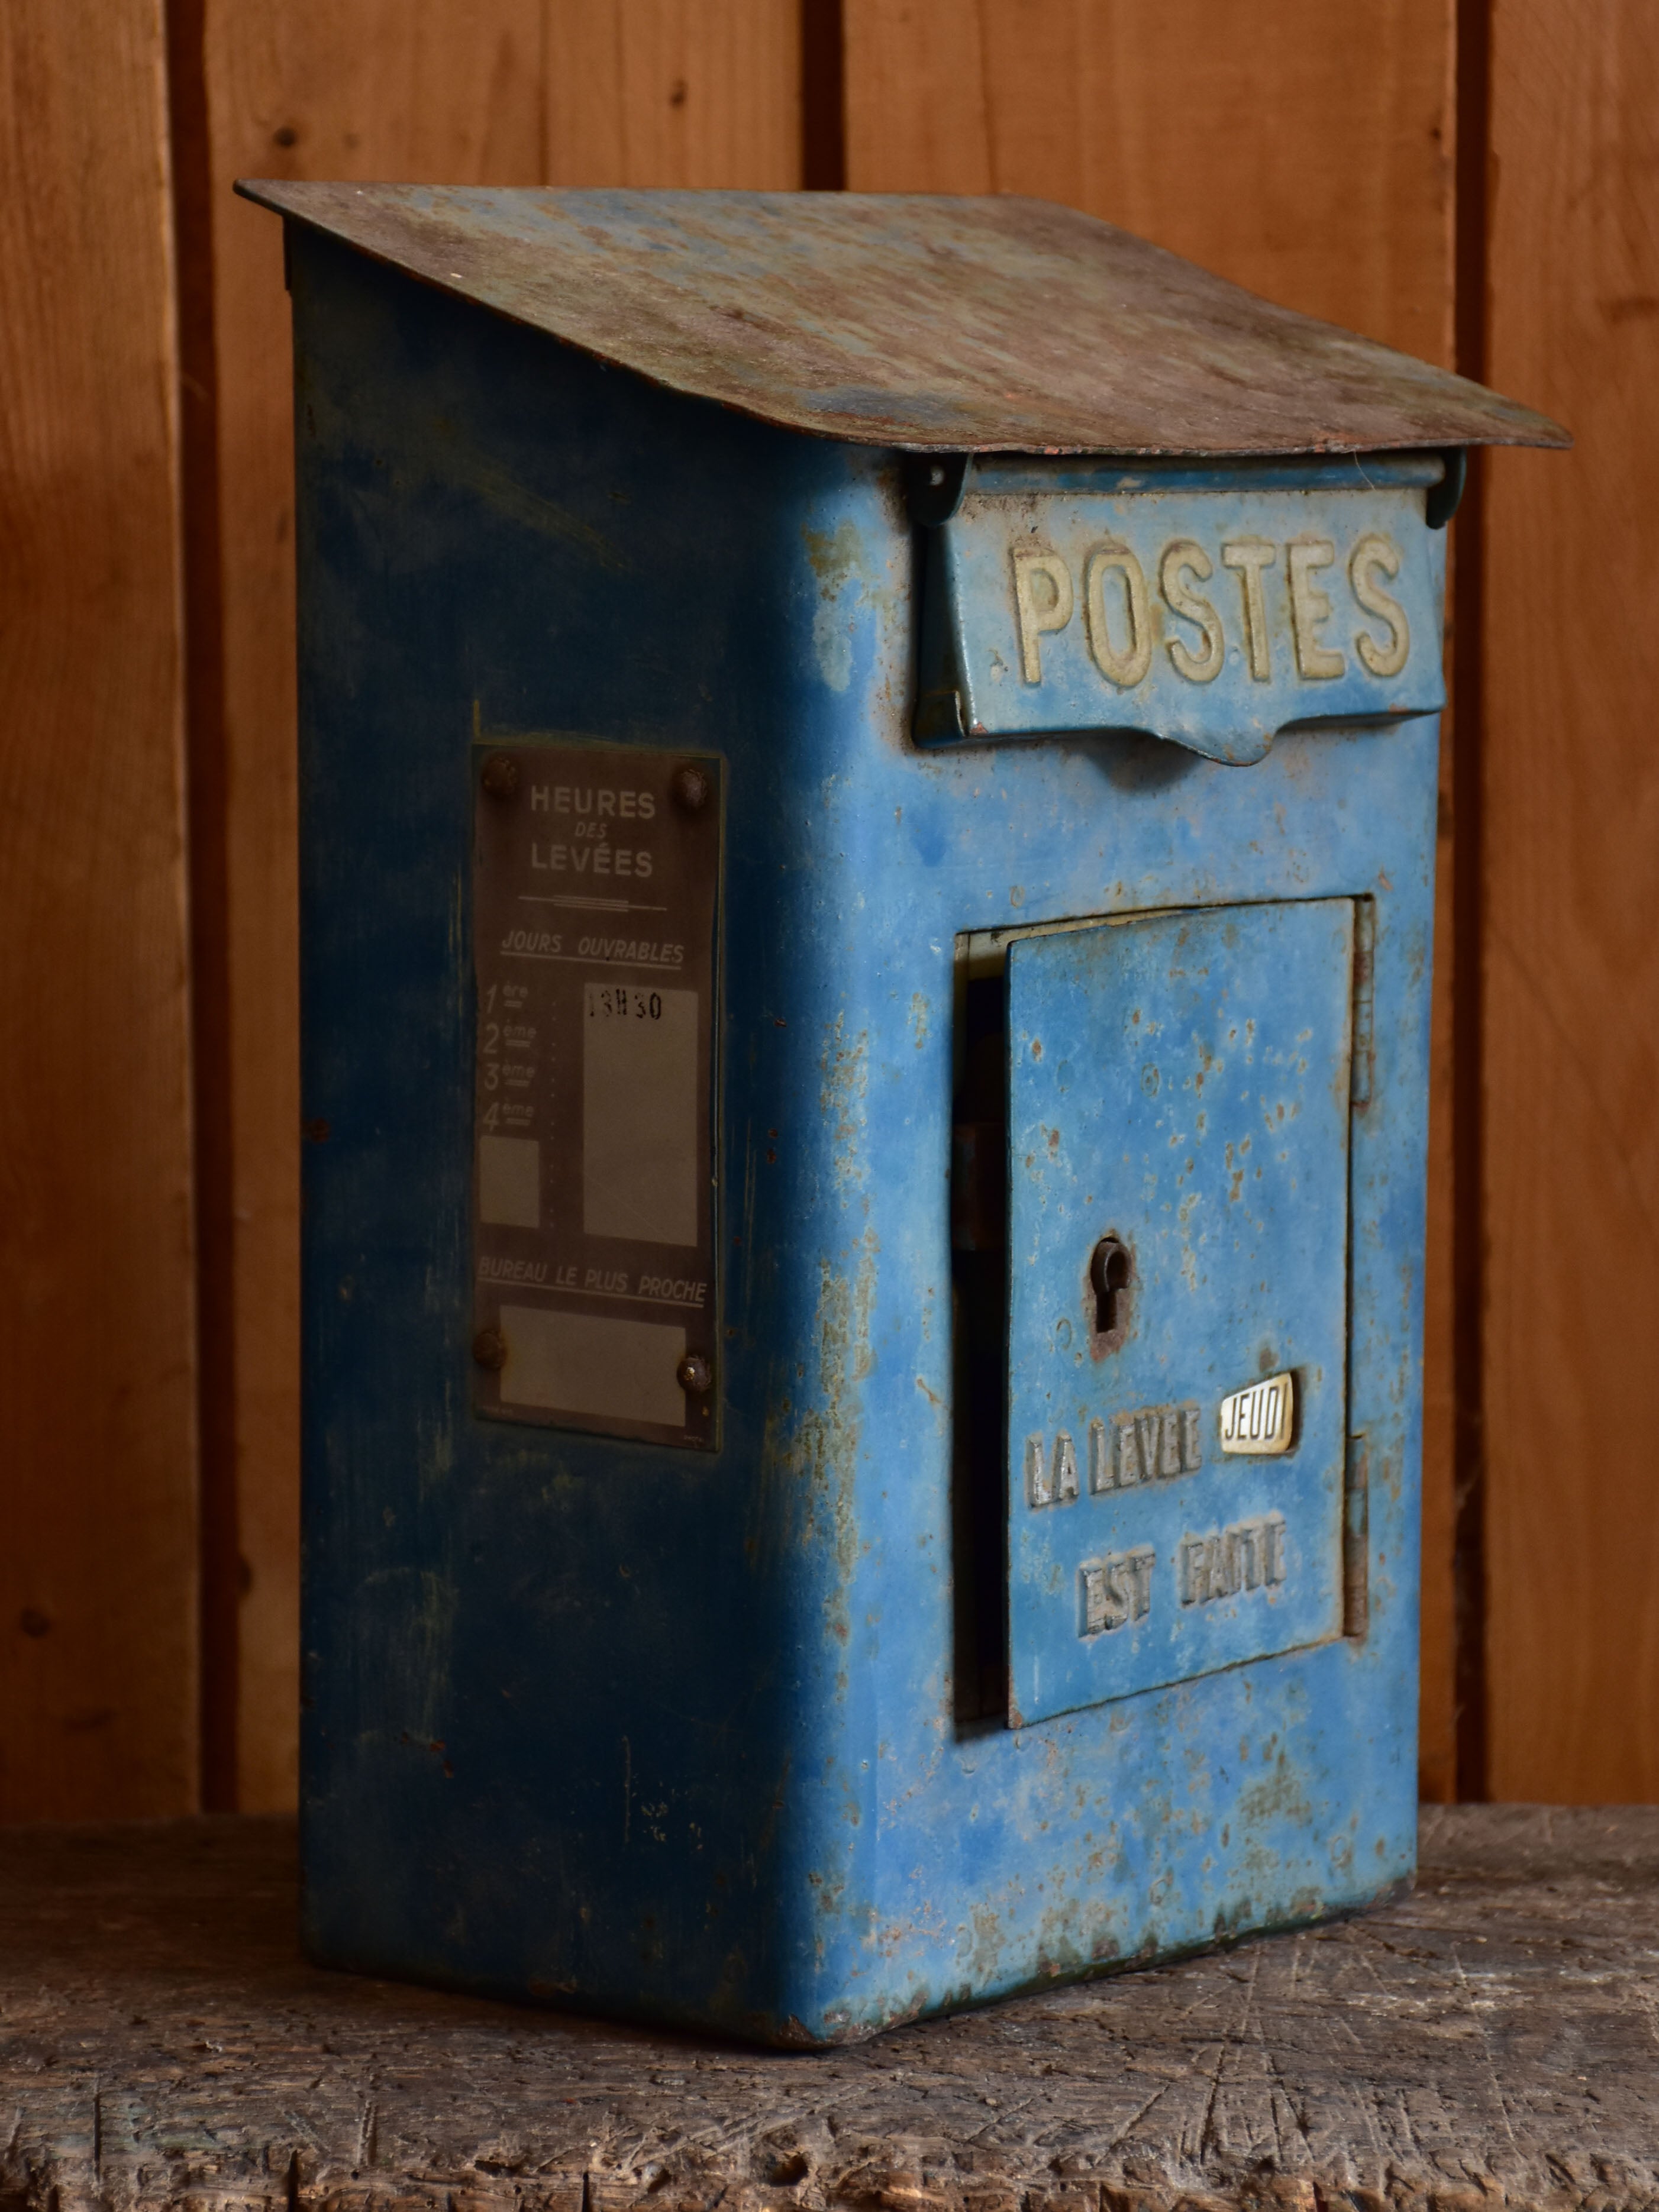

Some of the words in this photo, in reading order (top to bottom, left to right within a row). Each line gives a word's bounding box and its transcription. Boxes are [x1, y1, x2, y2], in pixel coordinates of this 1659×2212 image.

[1012, 538, 1410, 687] POSTES
[531, 784, 656, 819] HEURES
[574, 822, 608, 839] DES
[532, 842, 653, 878] LEVÉES
[502, 931, 562, 952] JOURS
[577, 937, 685, 964] OUVRABLES
[478, 1256, 548, 1283] BUREAU
[555, 1266, 578, 1286] LE
[584, 1269, 629, 1293] PLUS
[638, 1275, 708, 1303] PROCHE
[1026, 1432, 1079, 1510] LA
[1224, 1382, 1289, 1441] JEUDI
[1077, 1545, 1156, 1639] EST
[1179, 1511, 1287, 1607] FAITE
